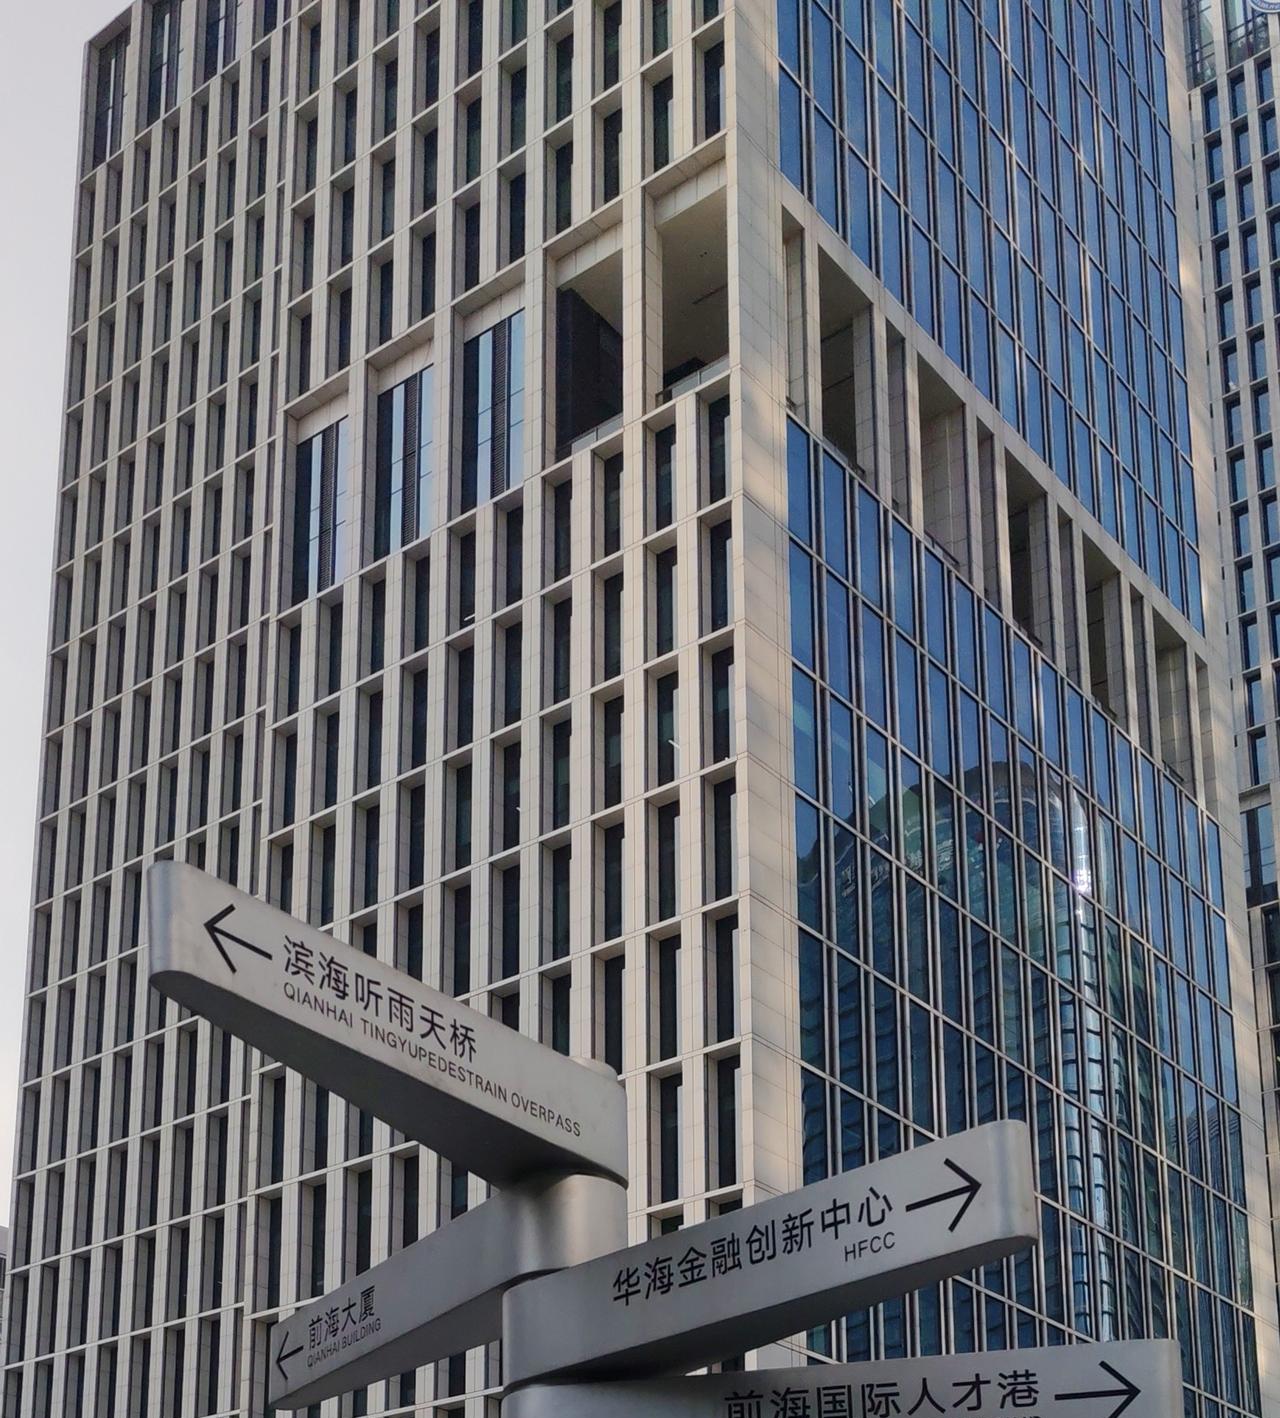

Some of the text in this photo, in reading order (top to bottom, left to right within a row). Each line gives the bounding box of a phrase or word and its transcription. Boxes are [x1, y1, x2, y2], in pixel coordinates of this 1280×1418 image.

[284, 935, 477, 1063] 滨海听雨天桥
[284, 982, 353, 1028] QIANHAI
[511, 1092, 582, 1137] OVERPASS
[613, 1186, 893, 1306] 华海金融创新中心
[844, 1231, 896, 1262] HFCC
[307, 1318, 381, 1367] QIANHAI BUILDING
[308, 1285, 375, 1351] 前海大厦
